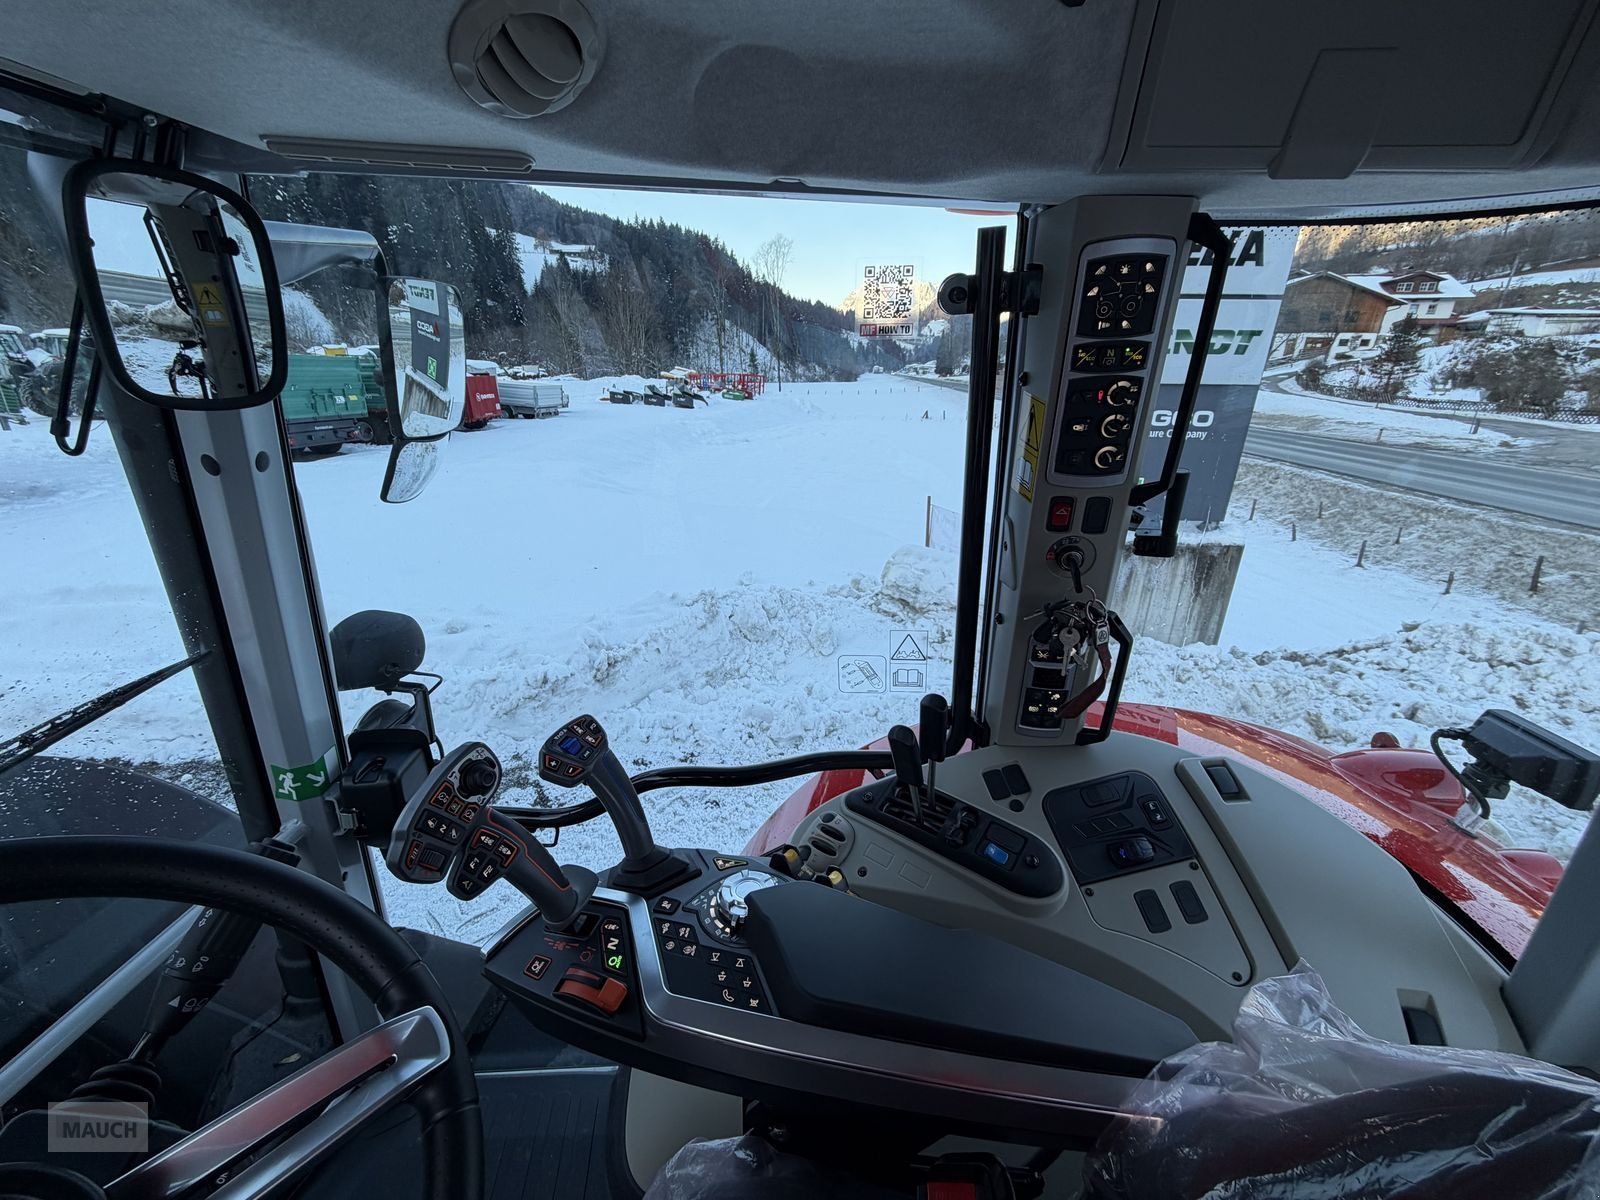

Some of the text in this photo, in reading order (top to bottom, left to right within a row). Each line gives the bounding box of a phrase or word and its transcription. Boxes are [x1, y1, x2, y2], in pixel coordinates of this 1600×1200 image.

[861, 325, 911, 335] MF HOW TO
[1166, 429, 1208, 441] Cpany
[469, 857, 480, 870] F1
[483, 864, 494, 878] F2
